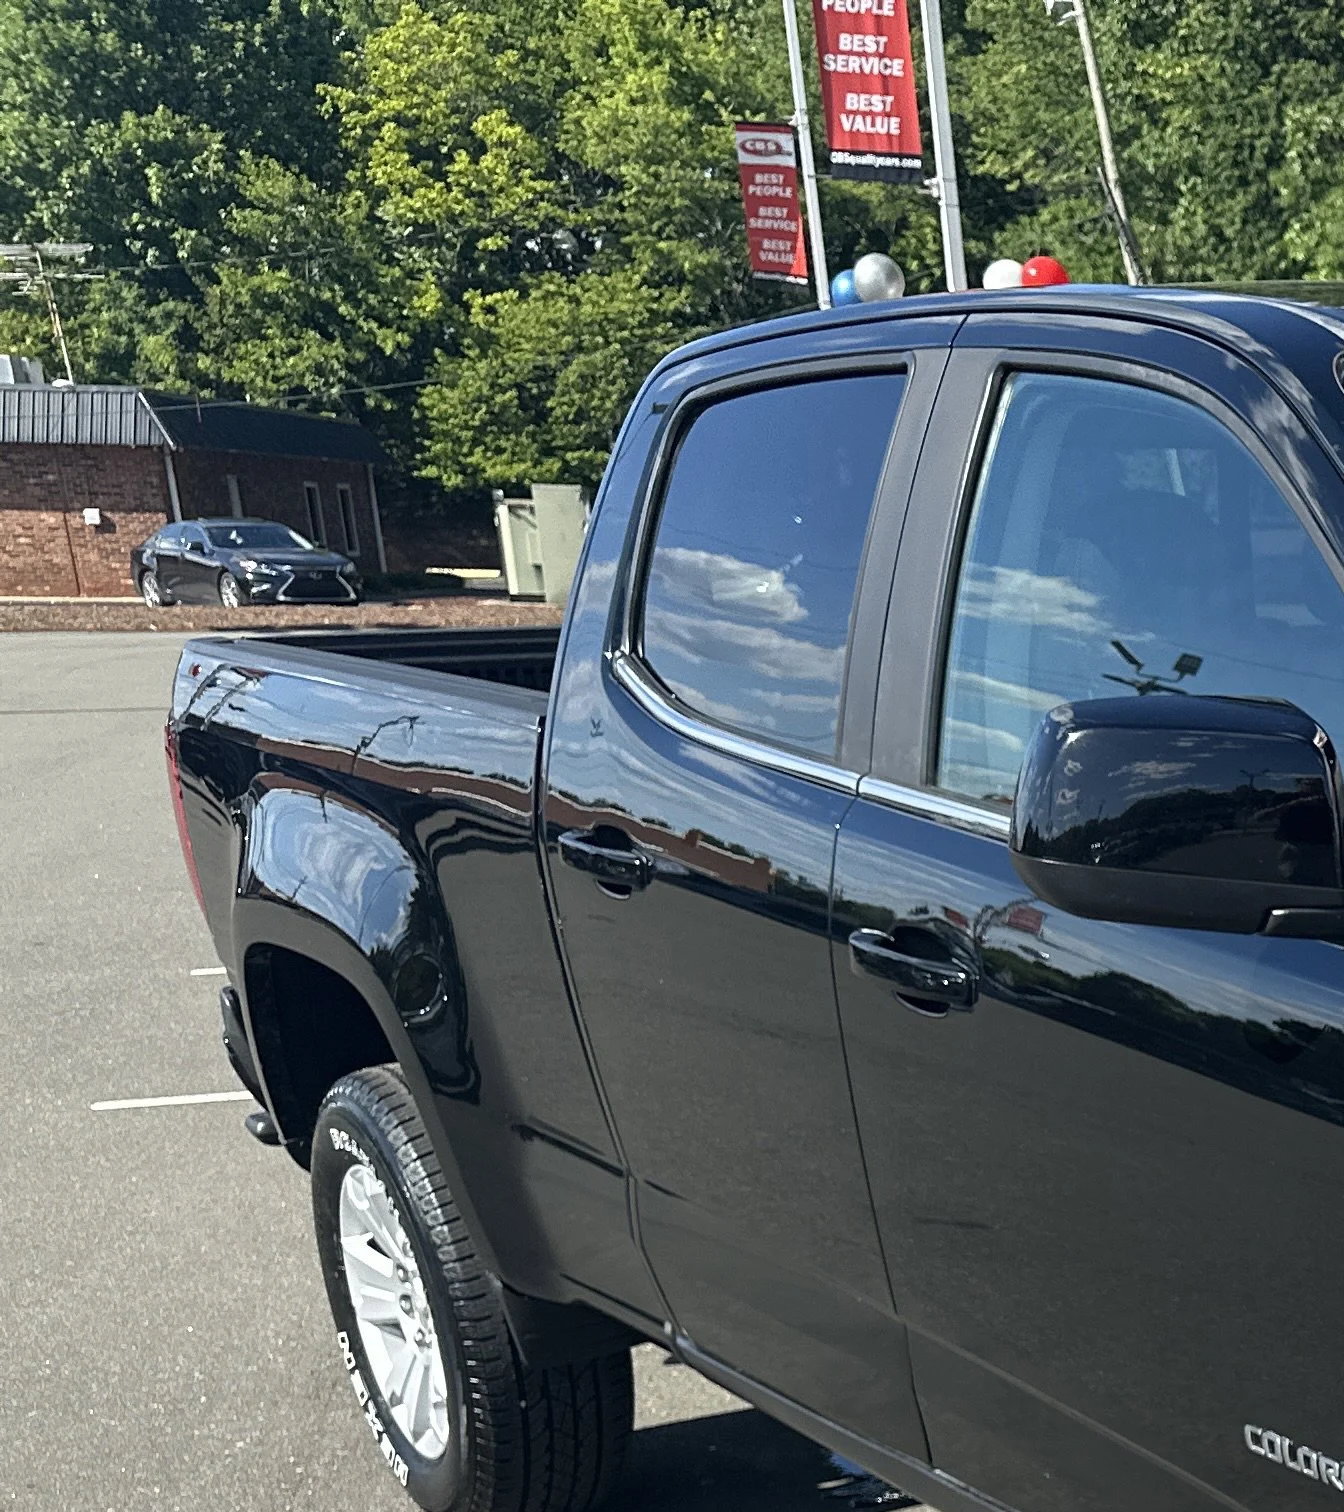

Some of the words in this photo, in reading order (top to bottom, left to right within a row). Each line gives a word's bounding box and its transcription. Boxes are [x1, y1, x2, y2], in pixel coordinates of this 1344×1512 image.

[821, 0, 896, 17] PEOPLE
[838, 33, 888, 54] BEST
[823, 53, 905, 77] SERVICE
[845, 92, 895, 113] BEST
[840, 113, 901, 136] VALUE
[754, 173, 785, 185] BEST
[748, 184, 793, 198] PEOPLE
[758, 206, 788, 218] BEST
[749, 217, 797, 233] SERVICE
[762, 239, 792, 251] BEST
